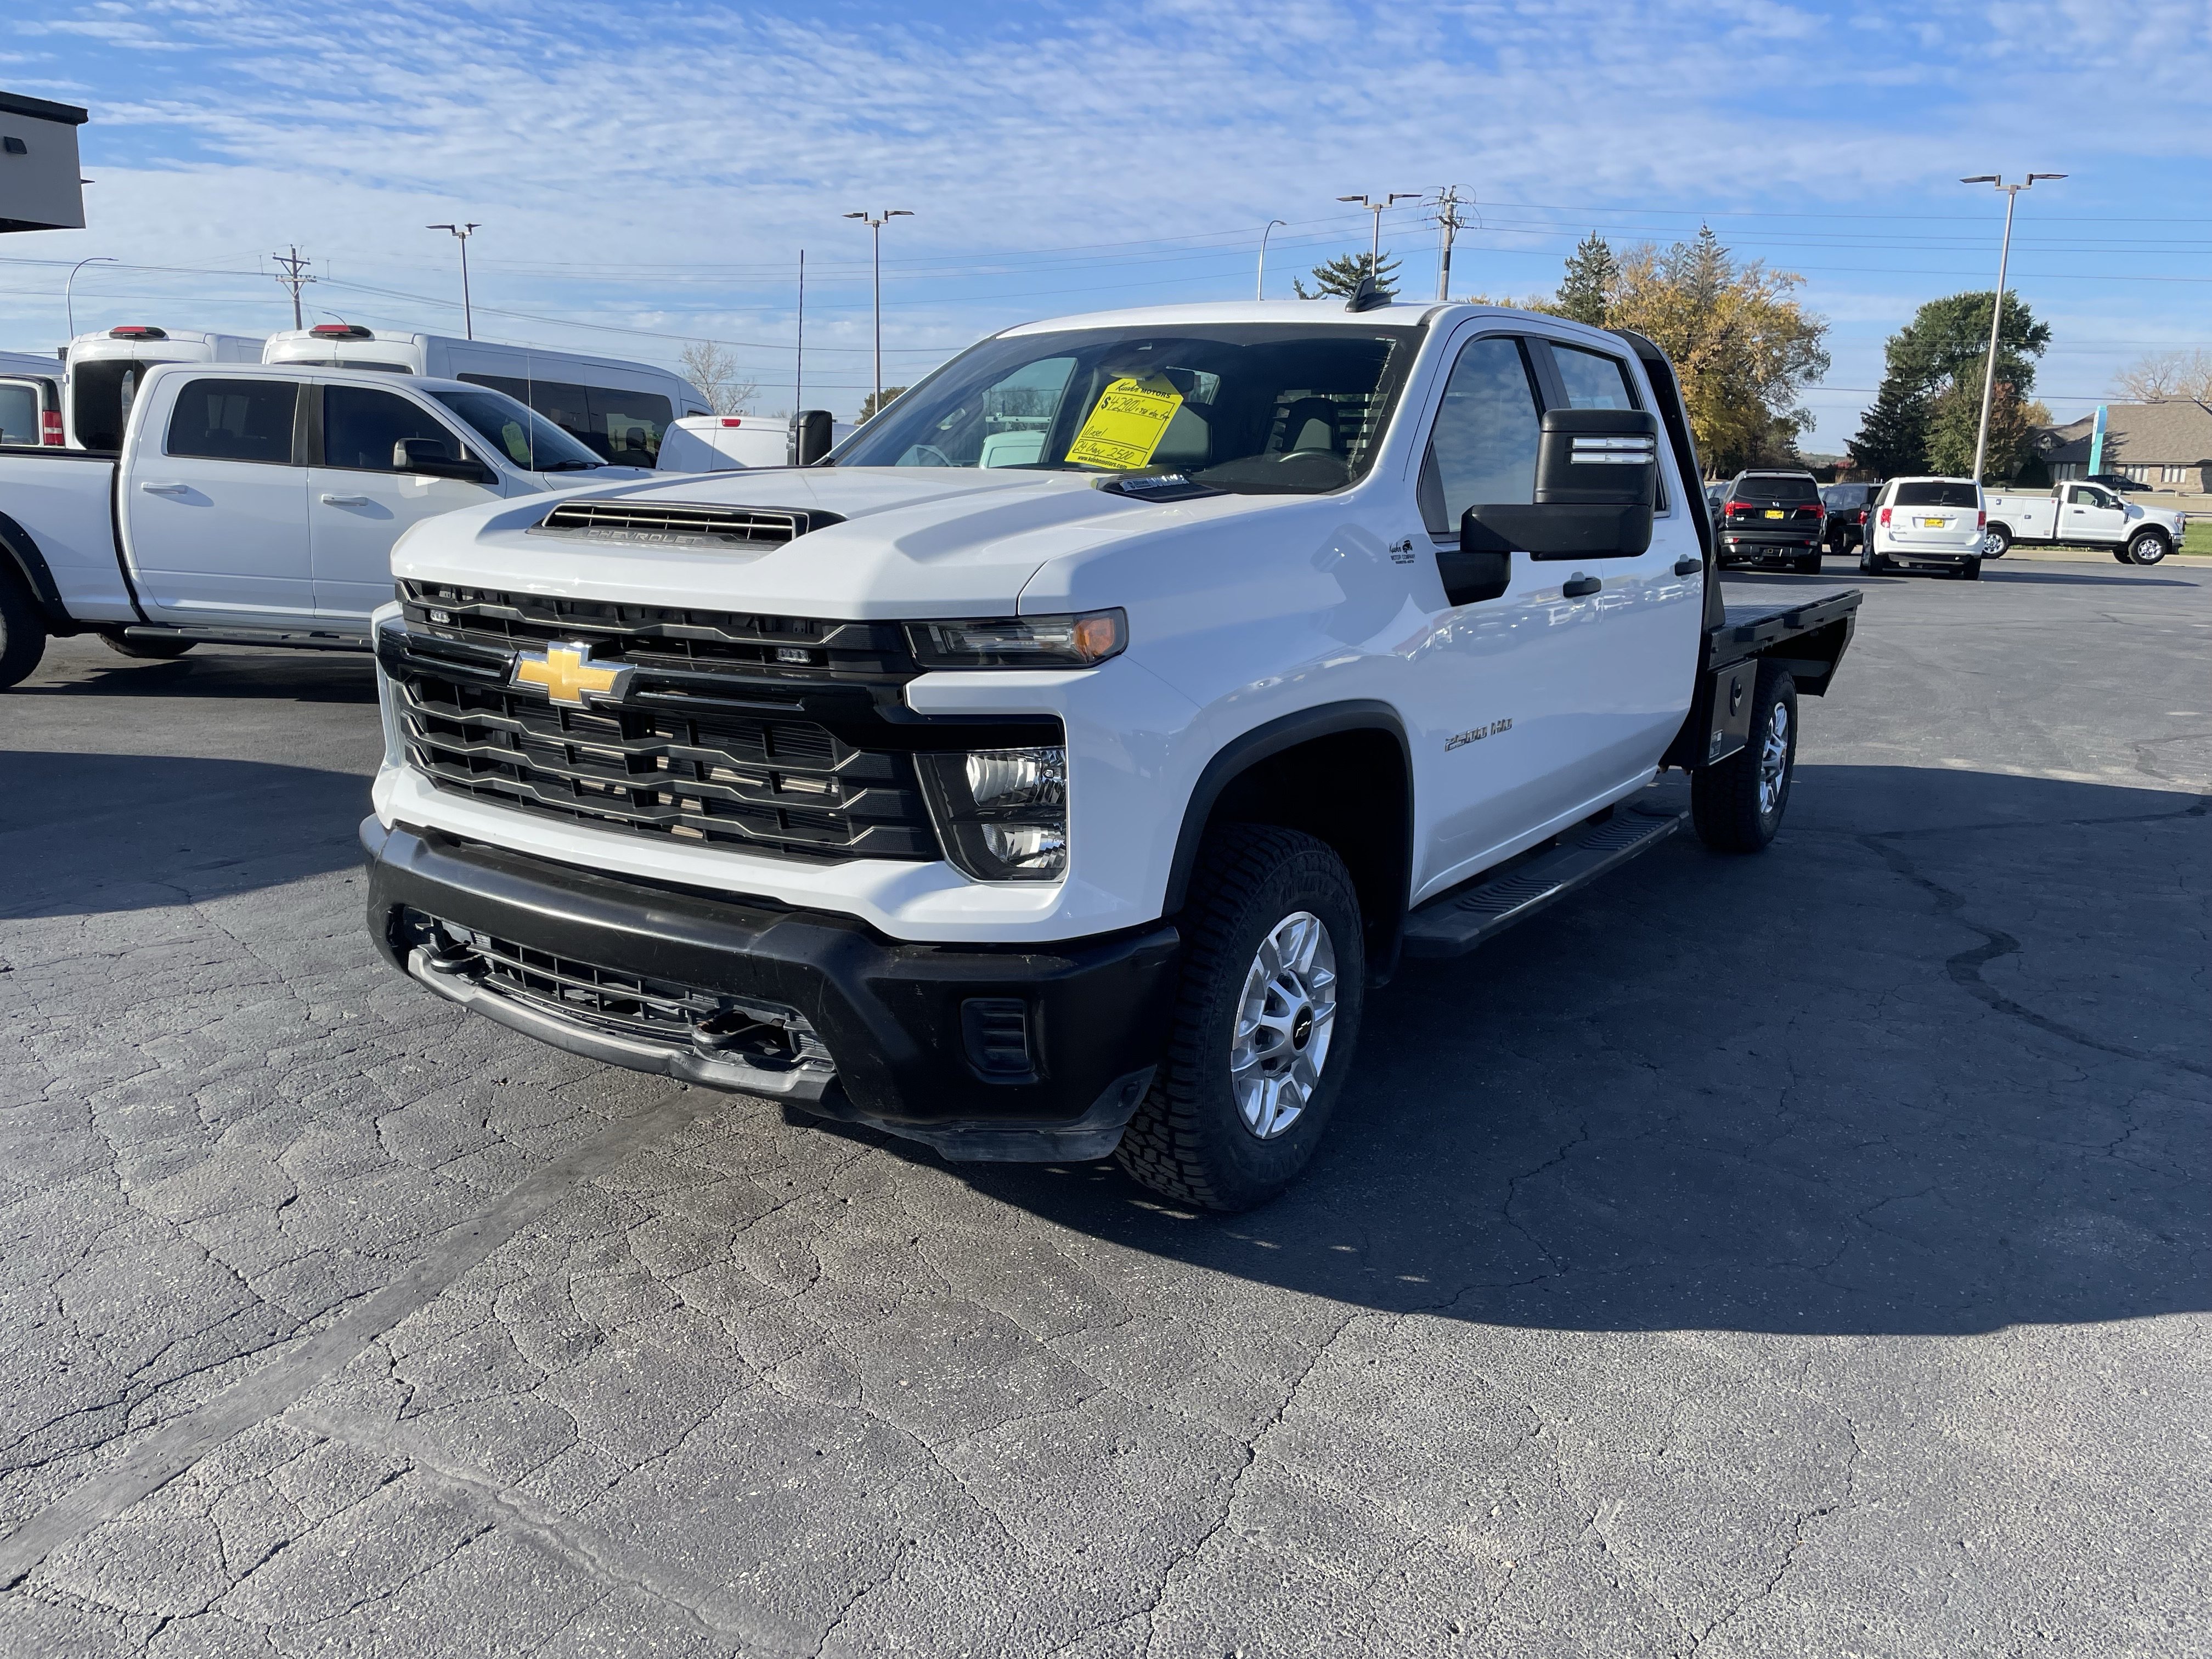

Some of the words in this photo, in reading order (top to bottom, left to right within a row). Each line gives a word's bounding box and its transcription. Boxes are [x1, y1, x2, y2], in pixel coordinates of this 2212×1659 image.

[1141, 388, 1171, 399] MOTORS
[1084, 426, 1108, 438] Diesel
[1107, 447, 1135, 461] 2500
[587, 530, 703, 544] CHEVROLET
[1444, 726, 1488, 752] 2500
[1491, 718, 1513, 736] HD
